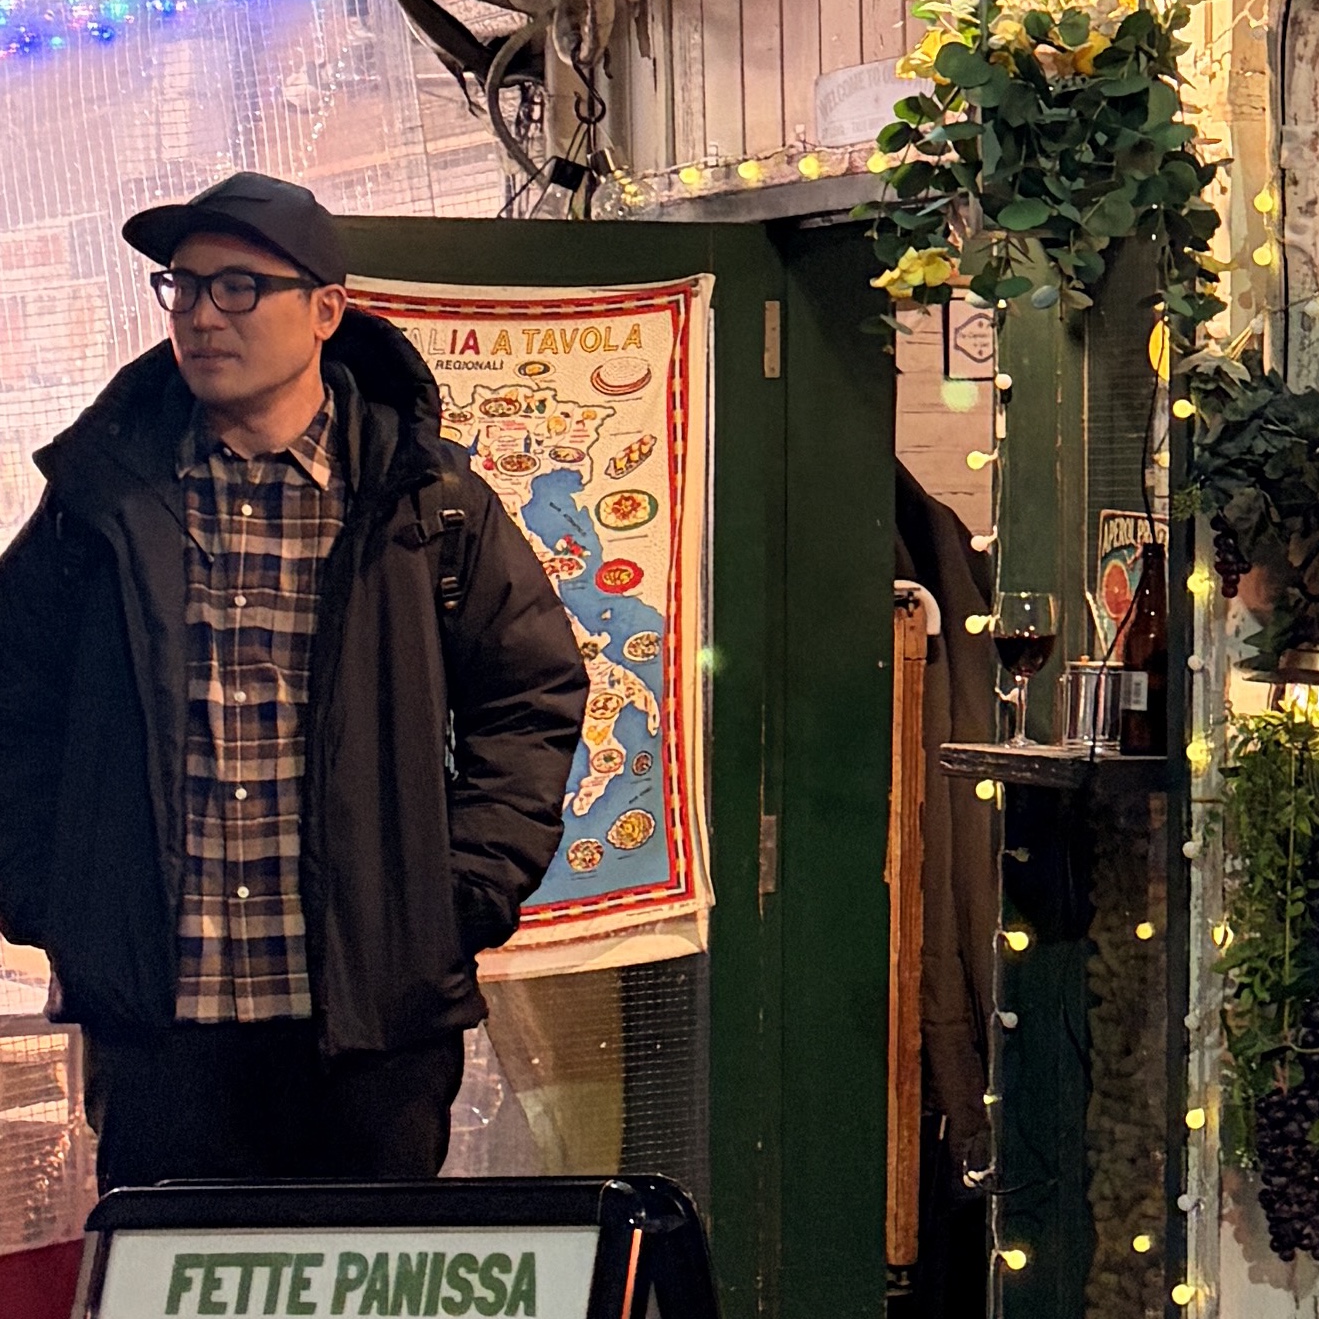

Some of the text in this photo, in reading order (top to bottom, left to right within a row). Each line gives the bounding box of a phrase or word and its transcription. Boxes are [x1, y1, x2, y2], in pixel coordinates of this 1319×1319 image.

[490, 328, 513, 356] A
[522, 323, 643, 356] TAVOLA
[434, 358, 505, 372] REGIONALI
[163, 1250, 538, 1319] FETTE PANISSA
